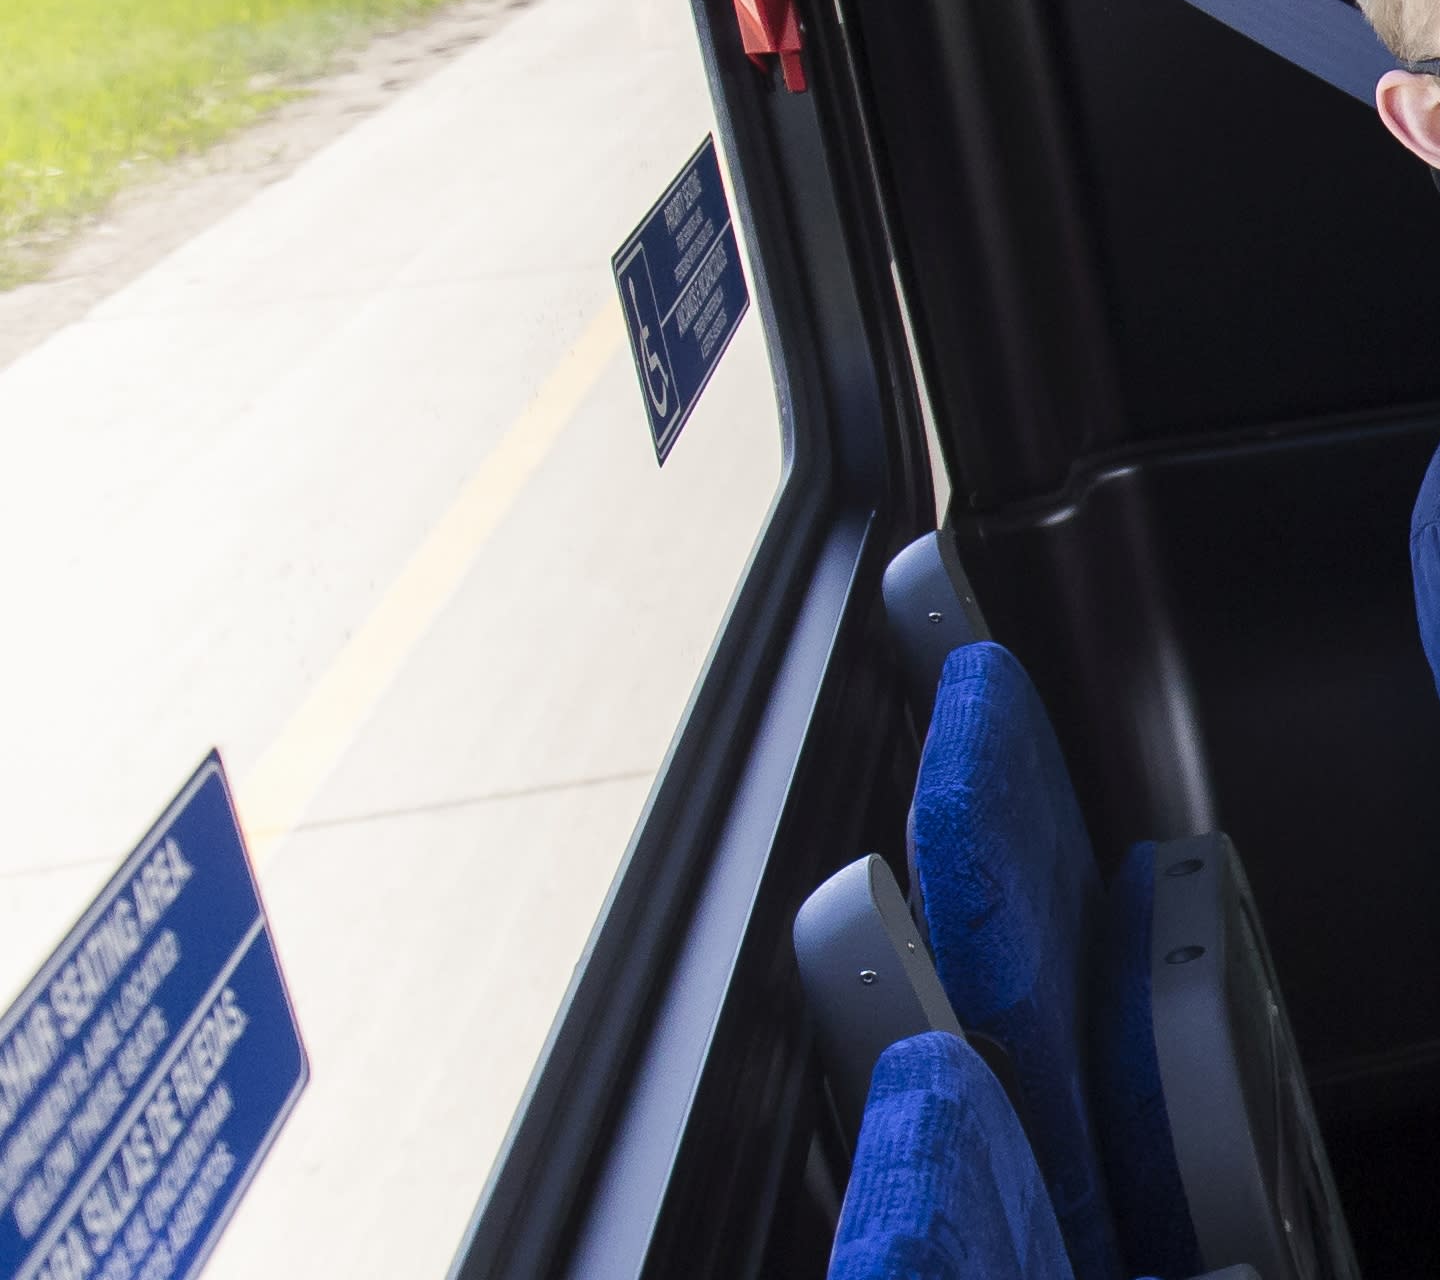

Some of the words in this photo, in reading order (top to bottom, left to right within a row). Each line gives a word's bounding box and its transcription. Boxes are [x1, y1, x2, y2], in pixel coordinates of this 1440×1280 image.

[133, 836, 194, 934] AREA
[81, 1122, 157, 1256] SILLAS
[145, 1076, 184, 1157] DE
[171, 986, 249, 1117] RUEDAS
